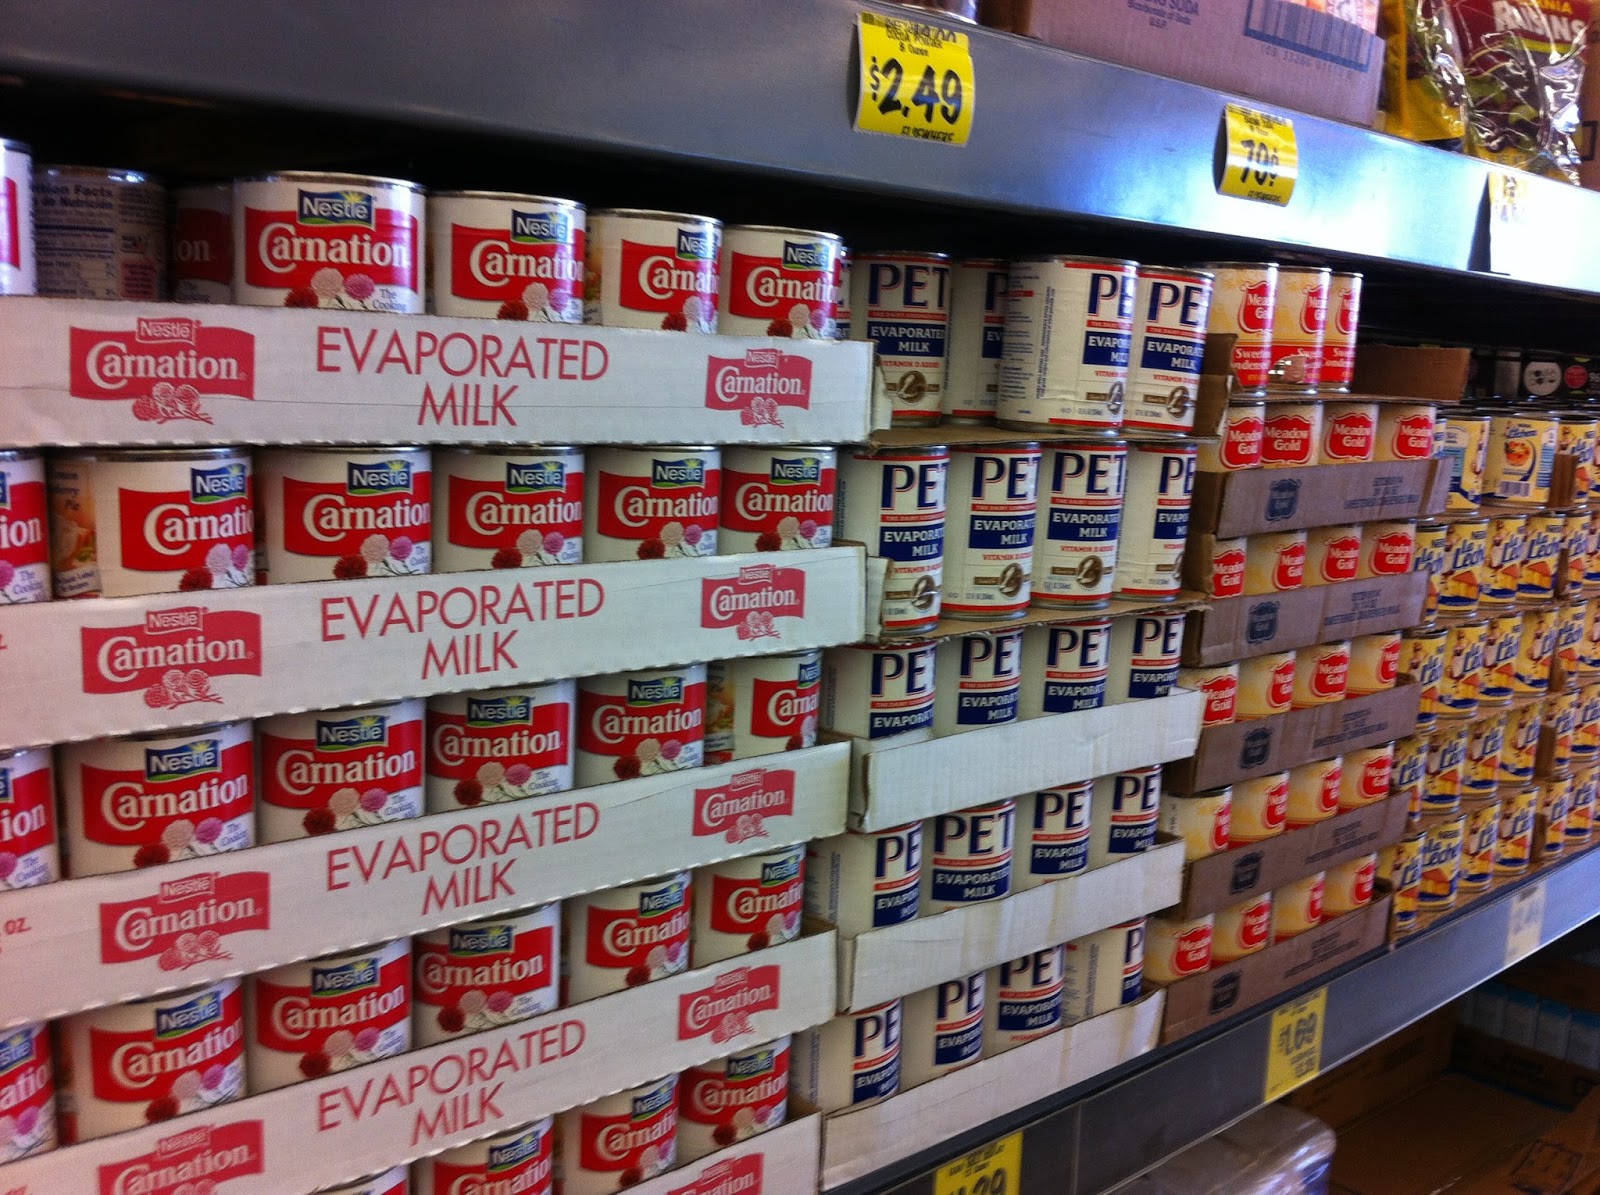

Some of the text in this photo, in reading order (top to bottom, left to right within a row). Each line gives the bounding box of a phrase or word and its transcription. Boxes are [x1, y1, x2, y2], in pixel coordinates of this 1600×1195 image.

[870, 56, 962, 125] $2.49
[259, 222, 407, 273] Carnation
[86, 340, 239, 389] Carnation
[316, 326, 610, 382] EVAPORATED
[898, 341, 930, 353] MILK
[416, 382, 519, 428] MILK
[715, 365, 802, 403] Carnation
[1273, 440, 1302, 452] Gold
[1342, 436, 1366, 448] Gold
[912, 543, 939, 557] MILK
[1001, 533, 1027, 545] MILK
[1079, 527, 1107, 538] MILK
[321, 578, 606, 643] EVAPORATED
[709, 585, 795, 621] Carnation
[98, 635, 247, 683] Carnation
[421, 629, 519, 681] MILK
[432, 723, 561, 766] Carnation
[276, 747, 416, 795] Carnation
[102, 773, 249, 832] Carnation
[701, 787, 786, 827] Carnation
[327, 801, 601, 891] EVAPORATED
[934, 809, 1015, 856] PET
[421, 859, 517, 916] MILK
[963, 885, 996, 898] MILK
[115, 895, 257, 952] Carnation
[417, 950, 544, 994] Carnation
[272, 983, 405, 1041] Carnation
[686, 984, 771, 1031] Carnation
[317, 1019, 586, 1132] EVAPORATED
[410, 1081, 504, 1147] MILK
[113, 1142, 251, 1195] Carnation
